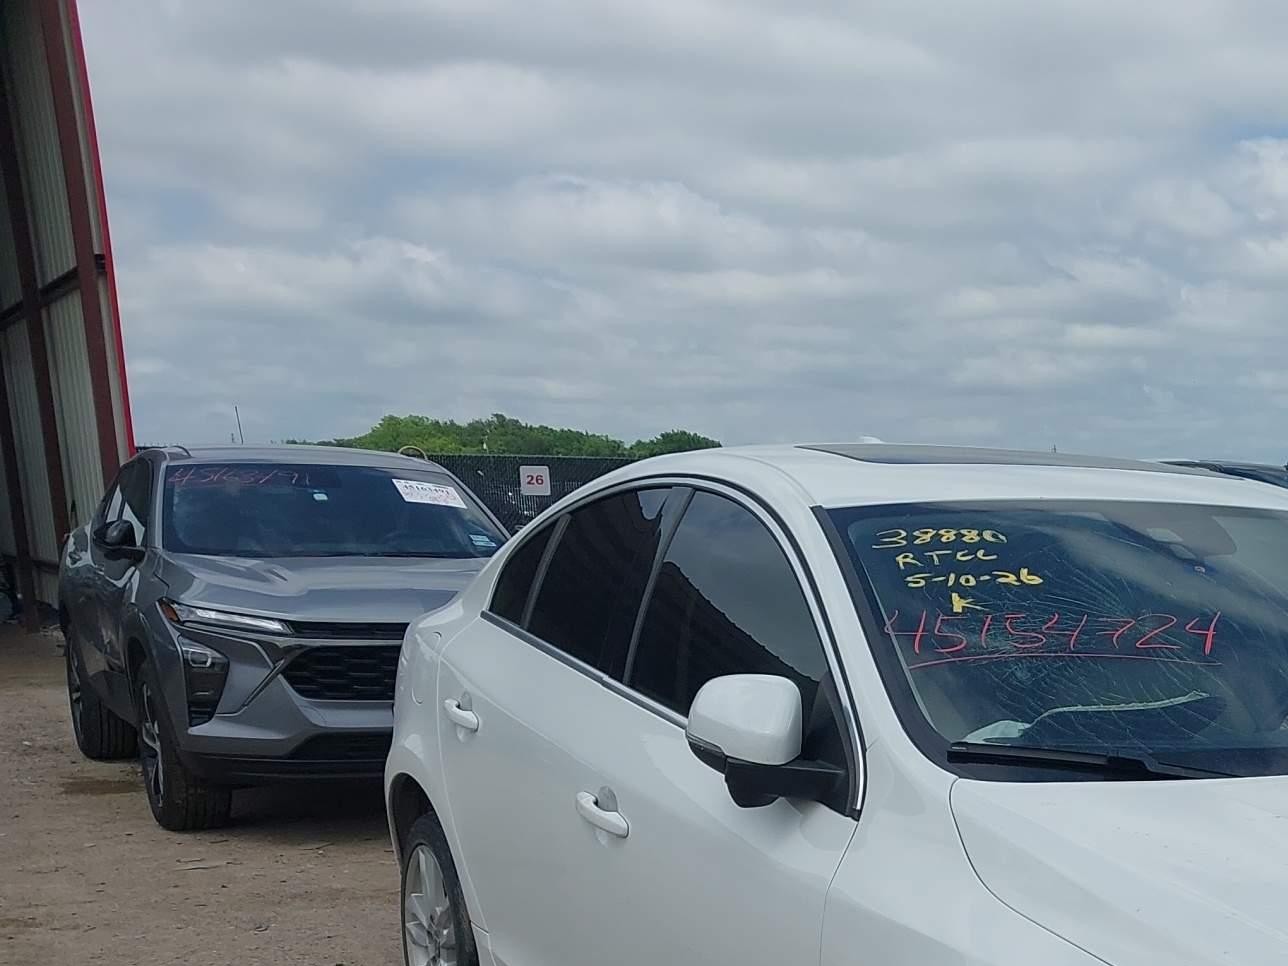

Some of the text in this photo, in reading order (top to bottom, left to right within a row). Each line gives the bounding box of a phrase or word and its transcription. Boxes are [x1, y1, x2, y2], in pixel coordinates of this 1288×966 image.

[526, 475, 544, 485] 26
[904, 568, 1044, 588] 5-10-26
[884, 611, 1221, 656] 45154724
